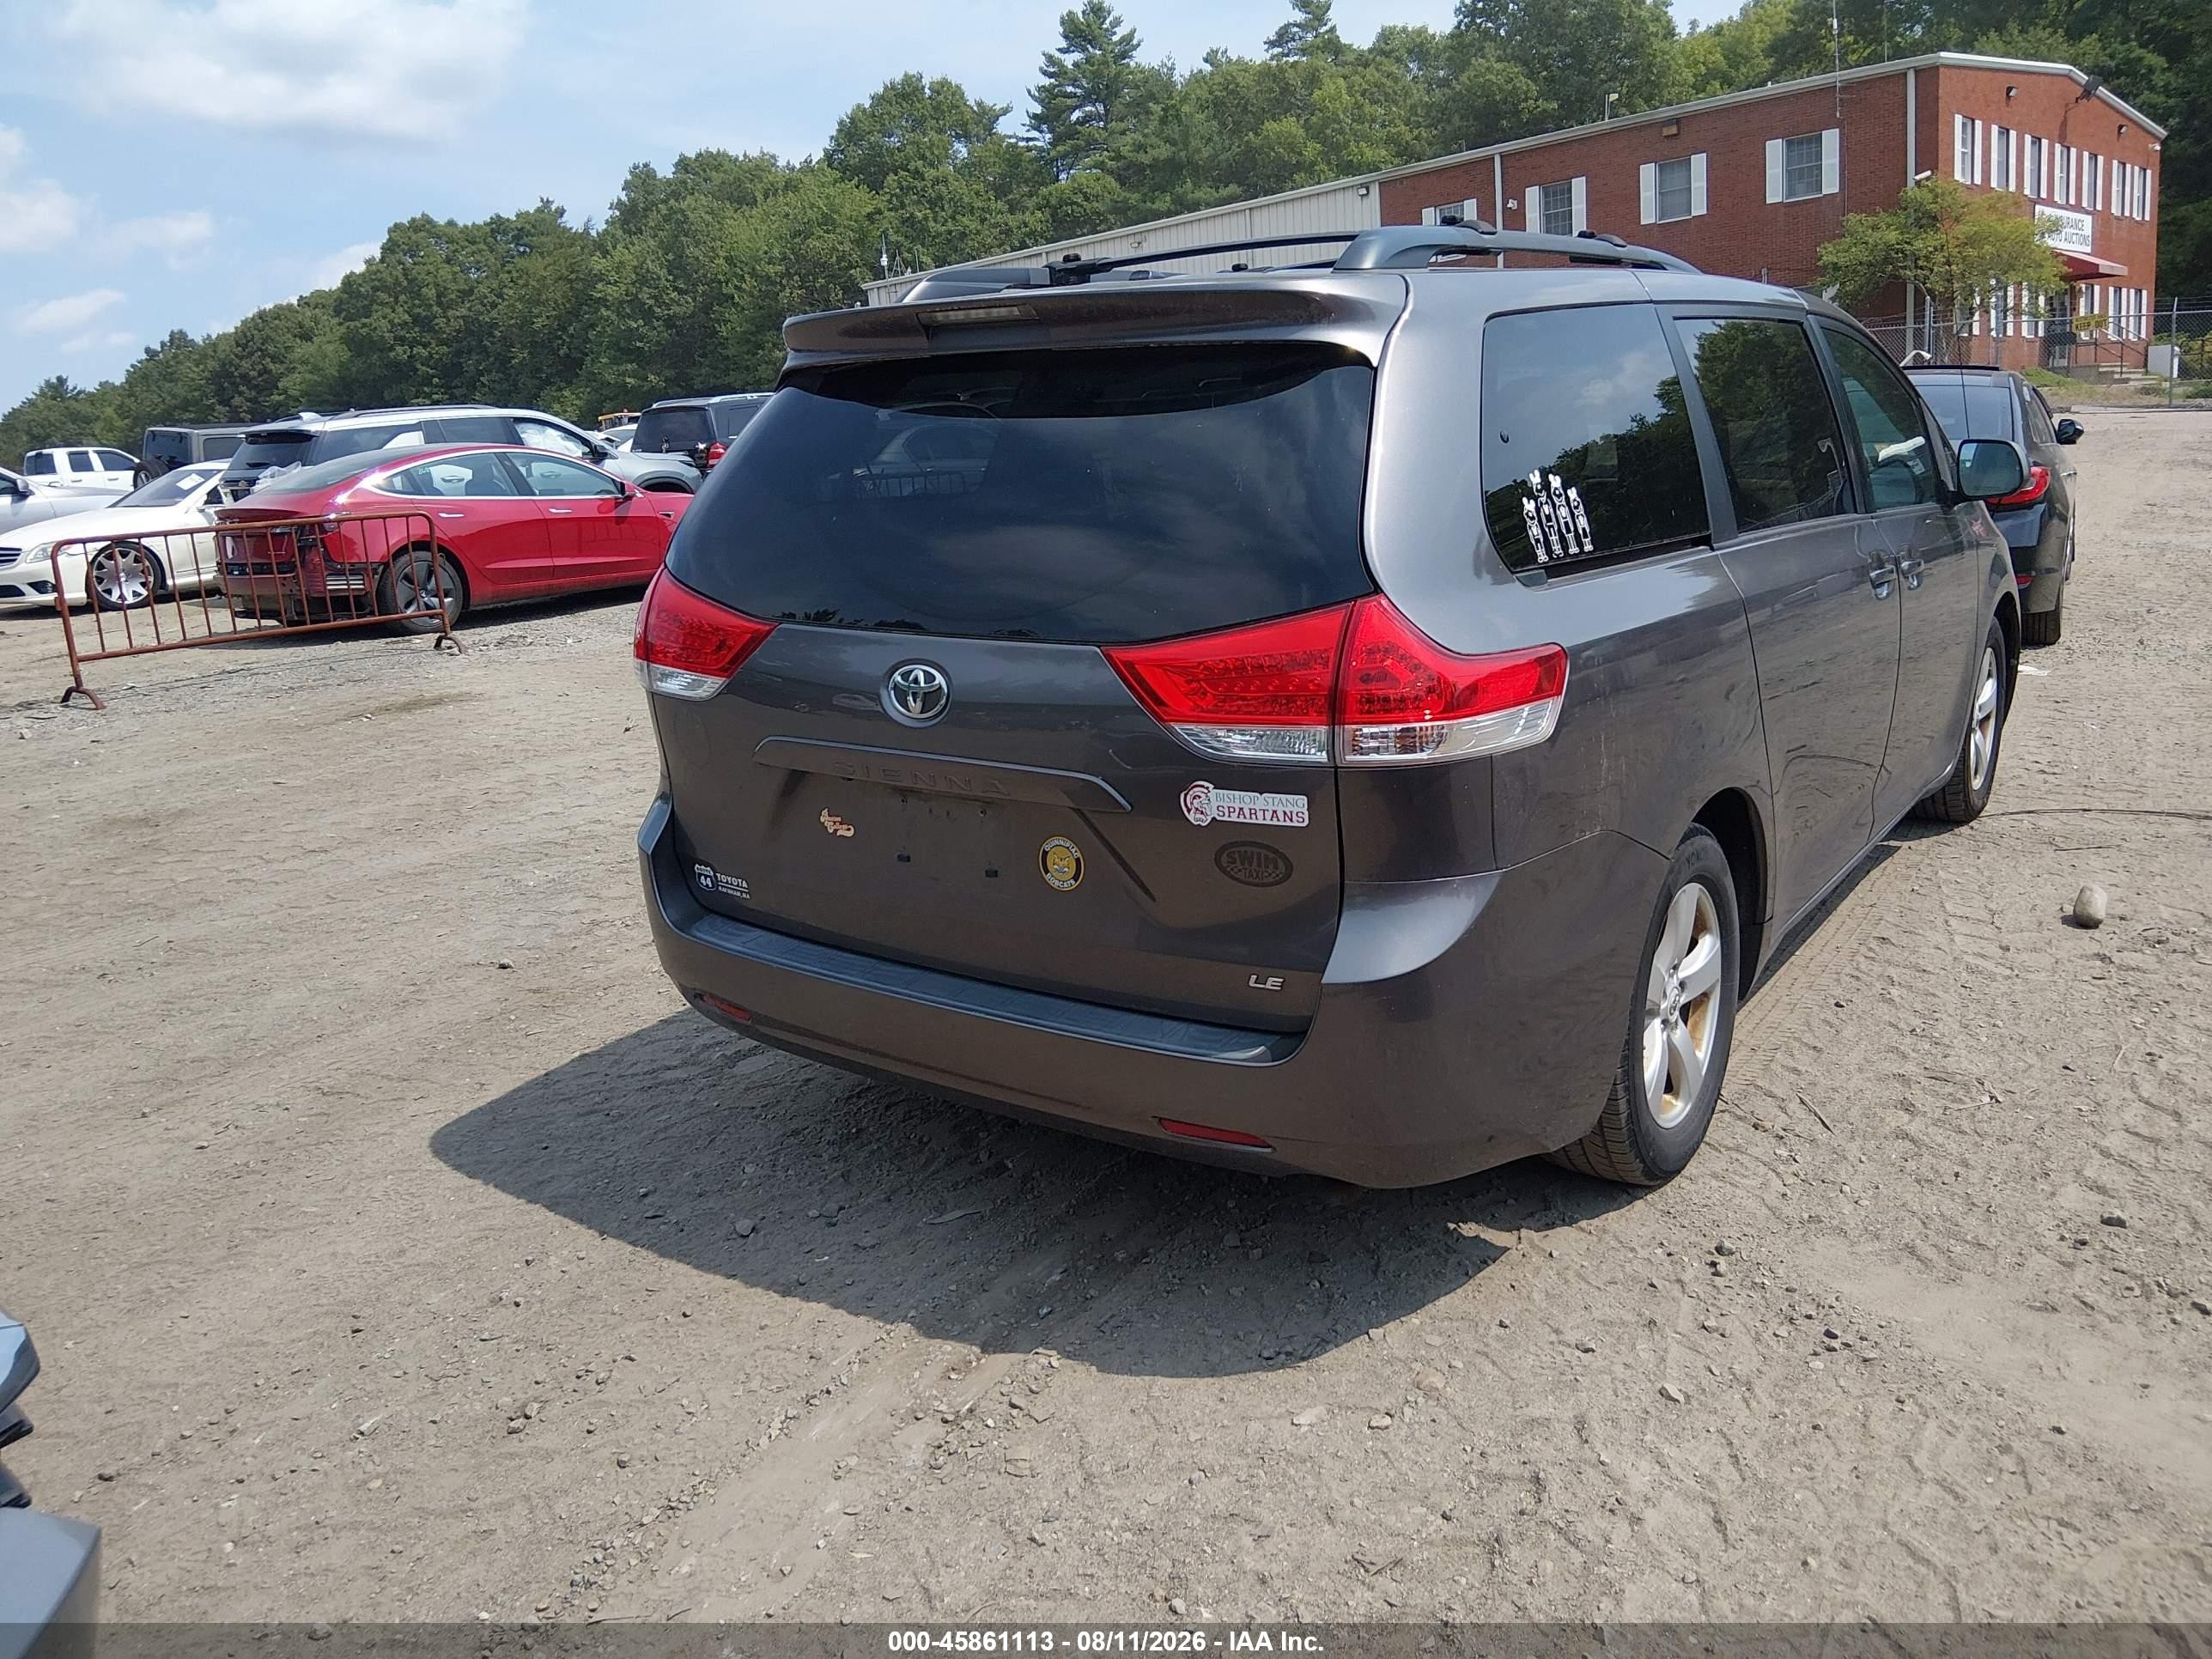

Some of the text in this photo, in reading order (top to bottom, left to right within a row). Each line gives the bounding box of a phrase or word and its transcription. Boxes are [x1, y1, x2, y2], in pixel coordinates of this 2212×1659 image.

[2064, 231, 2090, 247] AUCTIONS
[2075, 319, 2107, 331] KEEP OUT
[832, 761, 1011, 798] SIENNA
[1215, 792, 1305, 809] BISHOP STANG
[1216, 805, 1305, 823] SPARTANS
[700, 875, 713, 888] 44
[715, 872, 749, 888] TOYOTA
[1249, 975, 1285, 990] LE
